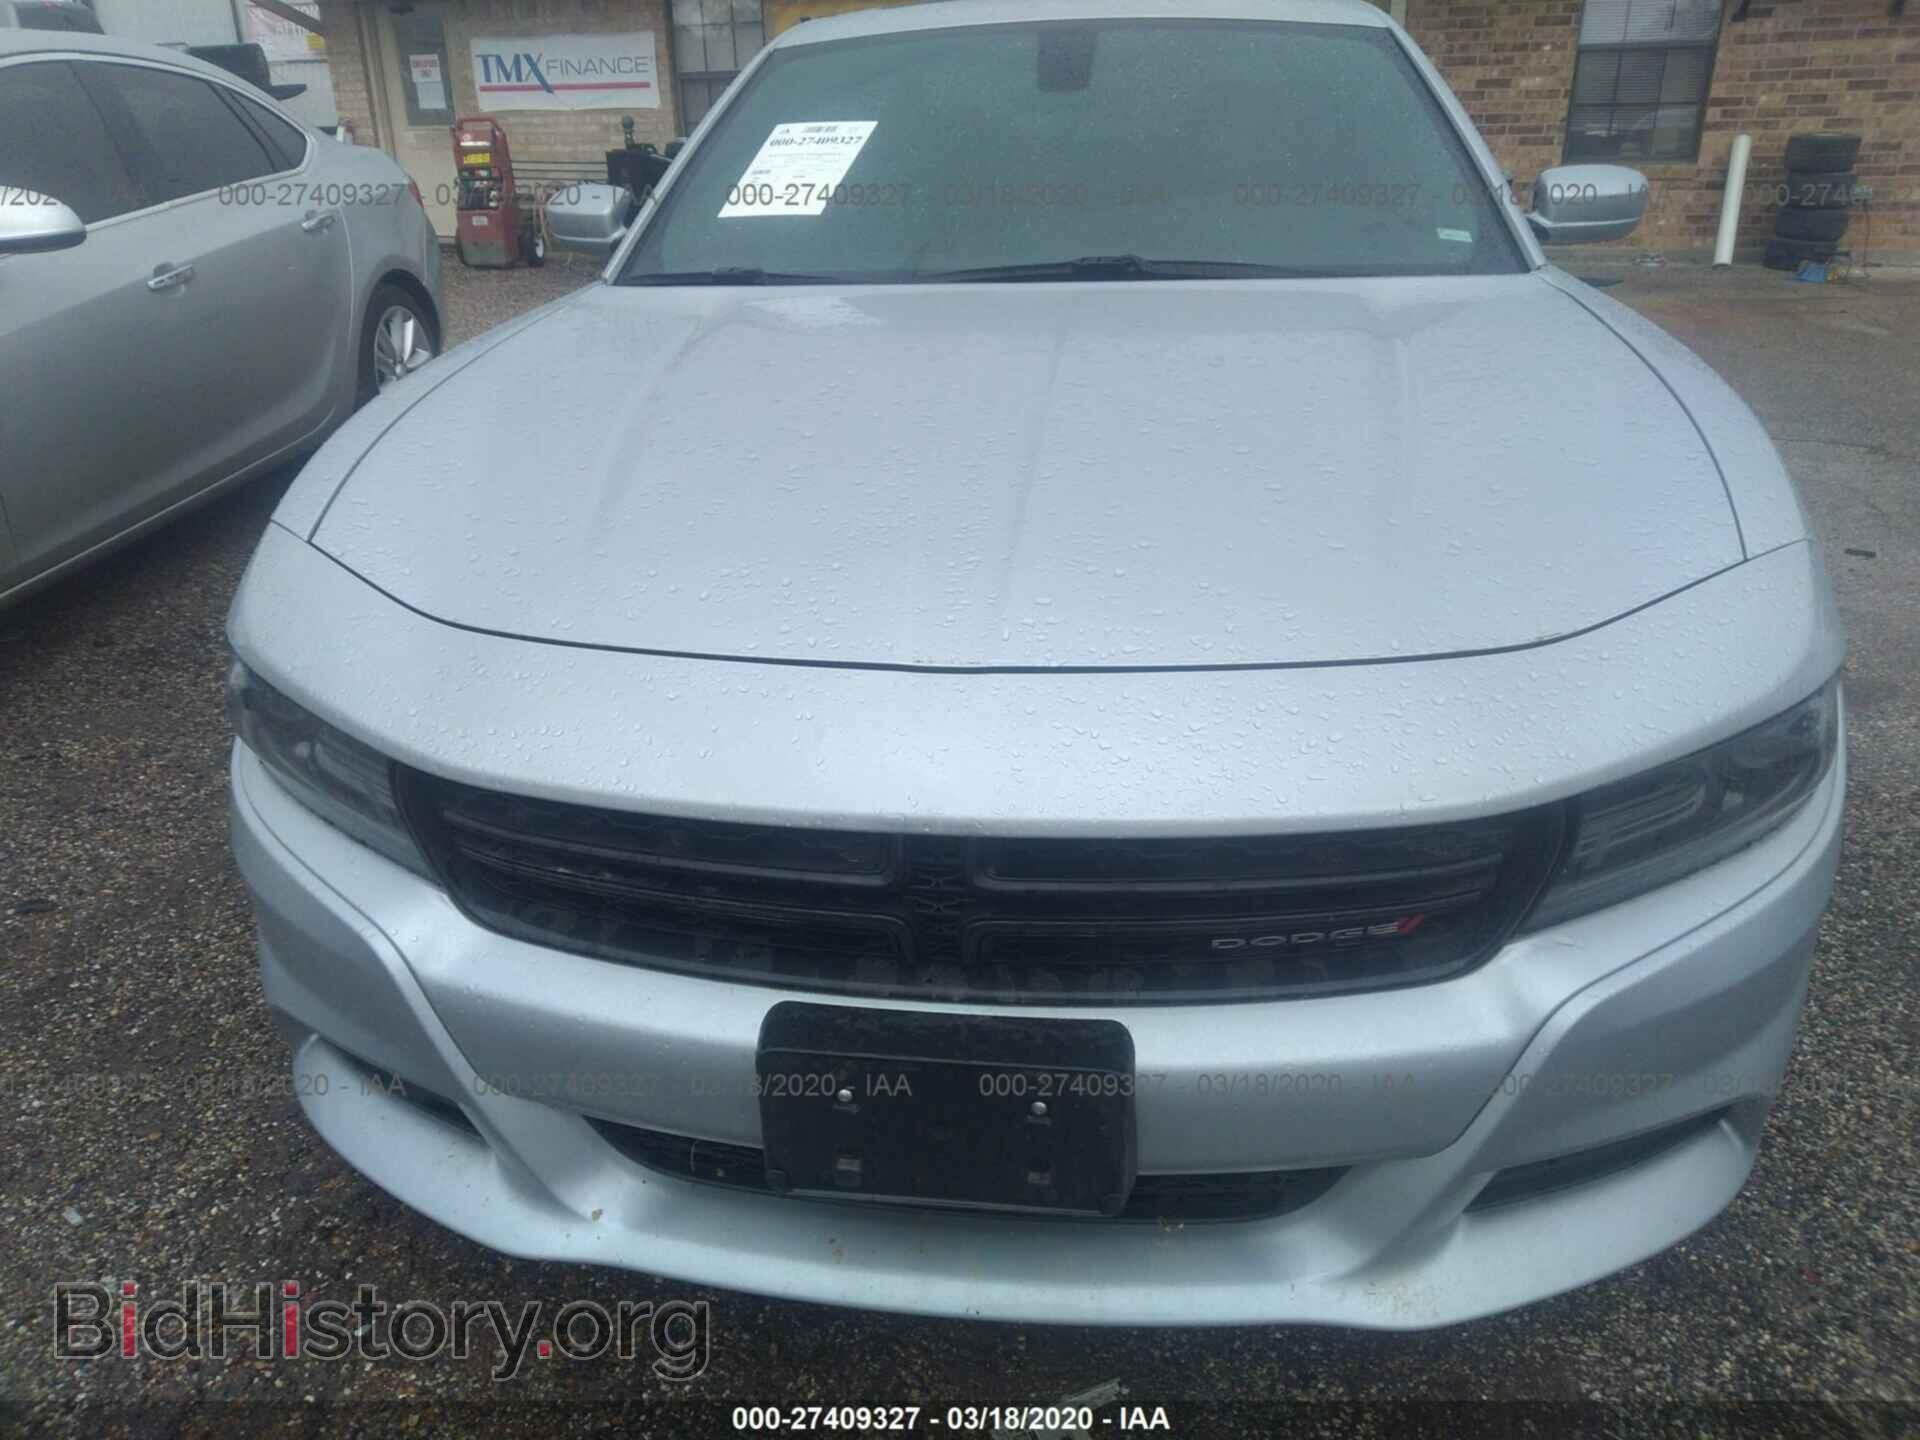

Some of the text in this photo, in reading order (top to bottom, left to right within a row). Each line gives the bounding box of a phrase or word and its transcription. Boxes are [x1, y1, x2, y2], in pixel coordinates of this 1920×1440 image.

[475, 52, 649, 95] TMX FINANCE
[1211, 922, 1399, 949] DODGE
